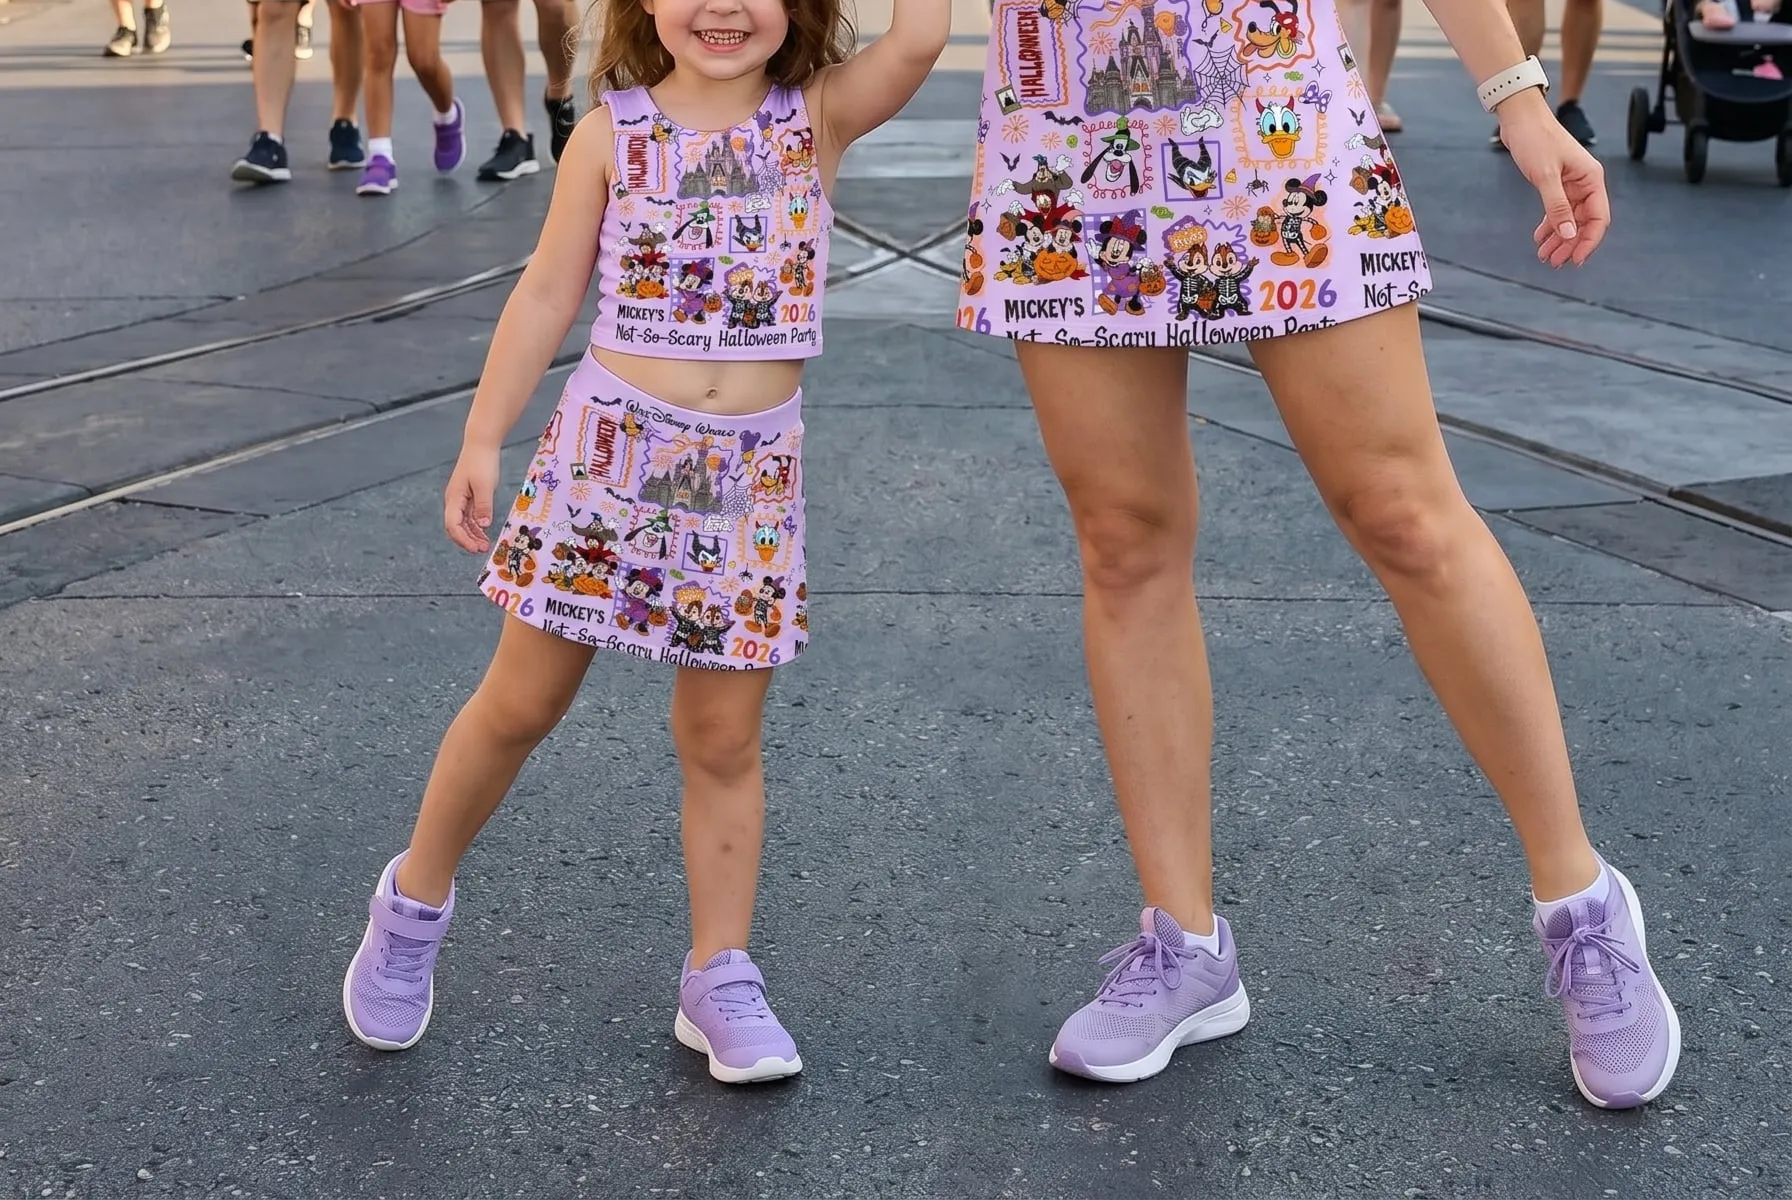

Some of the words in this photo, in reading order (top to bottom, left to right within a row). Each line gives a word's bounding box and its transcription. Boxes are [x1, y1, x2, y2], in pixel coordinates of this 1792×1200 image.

[1017, 10, 1050, 98] HALLOWEEN
[1259, 278, 1338, 311] 2026
[616, 303, 665, 322] MICKEY'S
[780, 303, 816, 324] 2026
[1004, 297, 1085, 323] MICKEY'S
[615, 322, 711, 352] Not-So-Scary
[718, 328, 787, 348] Halloween
[1166, 321, 1274, 347] Halloween
[544, 597, 606, 625] MICKEY'S
[730, 637, 781, 666] 2026
